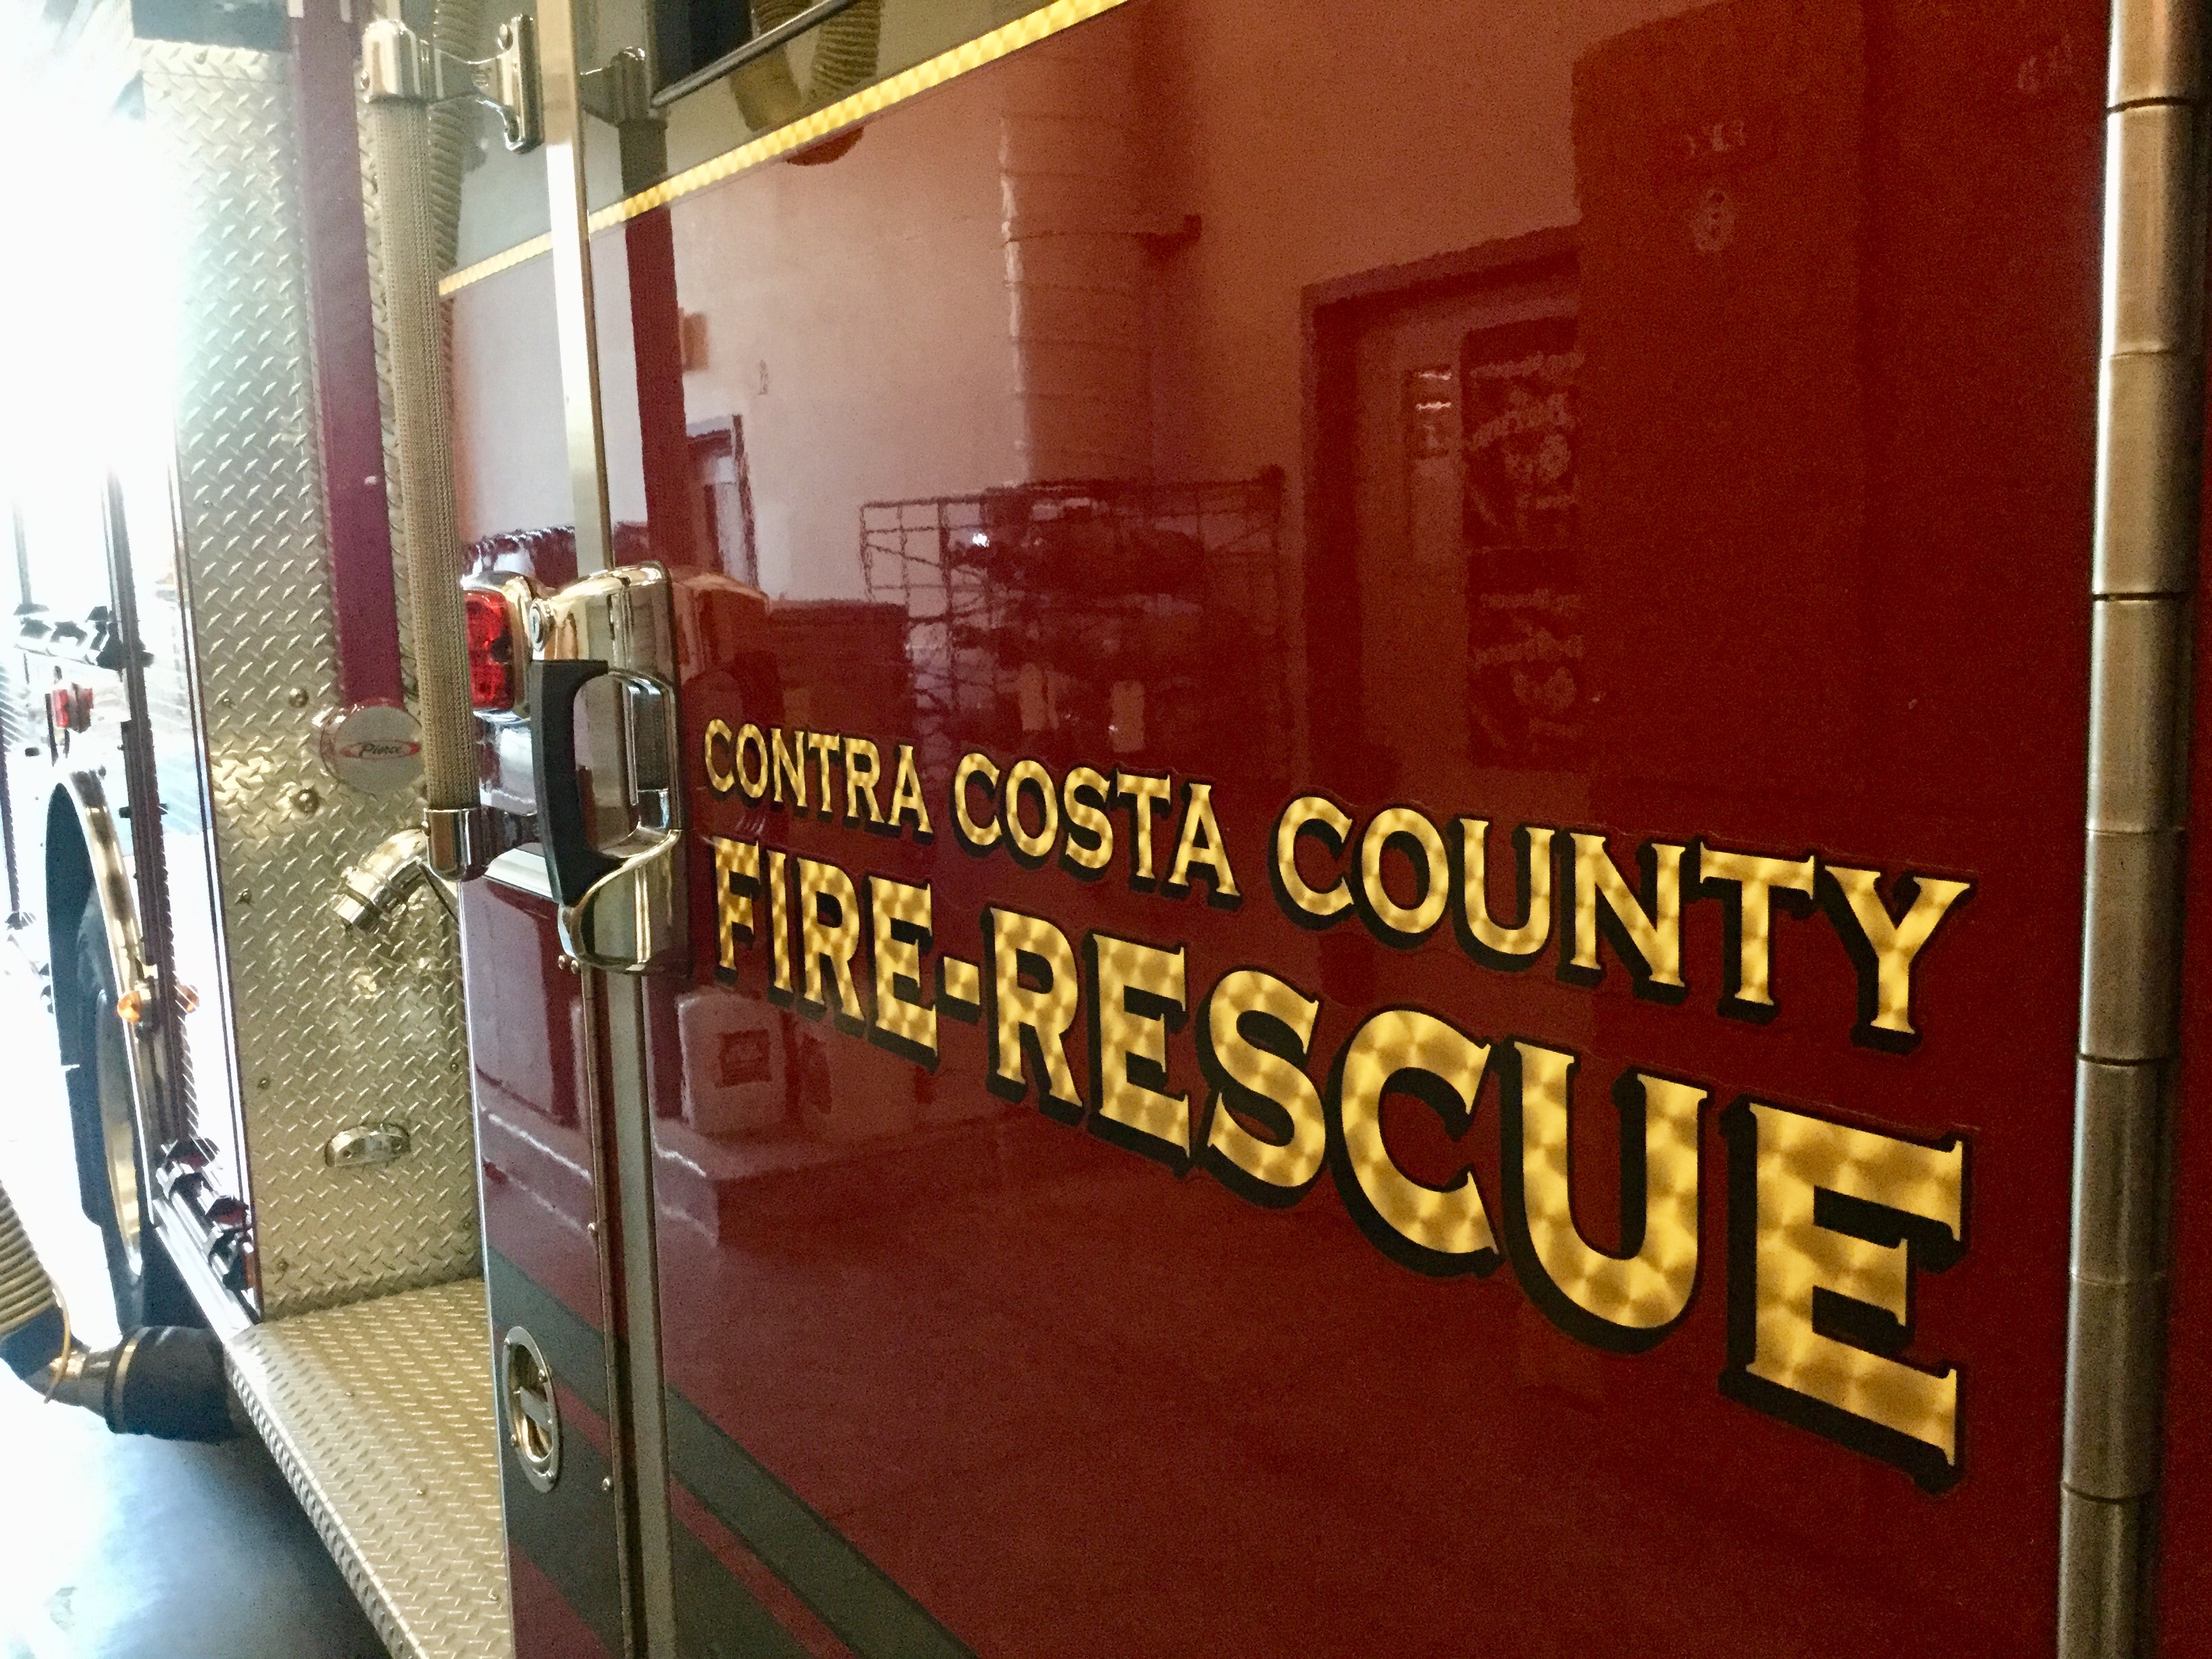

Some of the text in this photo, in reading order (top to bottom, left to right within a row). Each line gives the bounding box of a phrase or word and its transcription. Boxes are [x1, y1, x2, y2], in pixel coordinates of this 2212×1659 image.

[359, 741, 402, 758] Pierce
[703, 717, 1971, 1037] CONTRA COSTA COUNTY
[712, 835, 1964, 1467] FIRE-RESCUE
